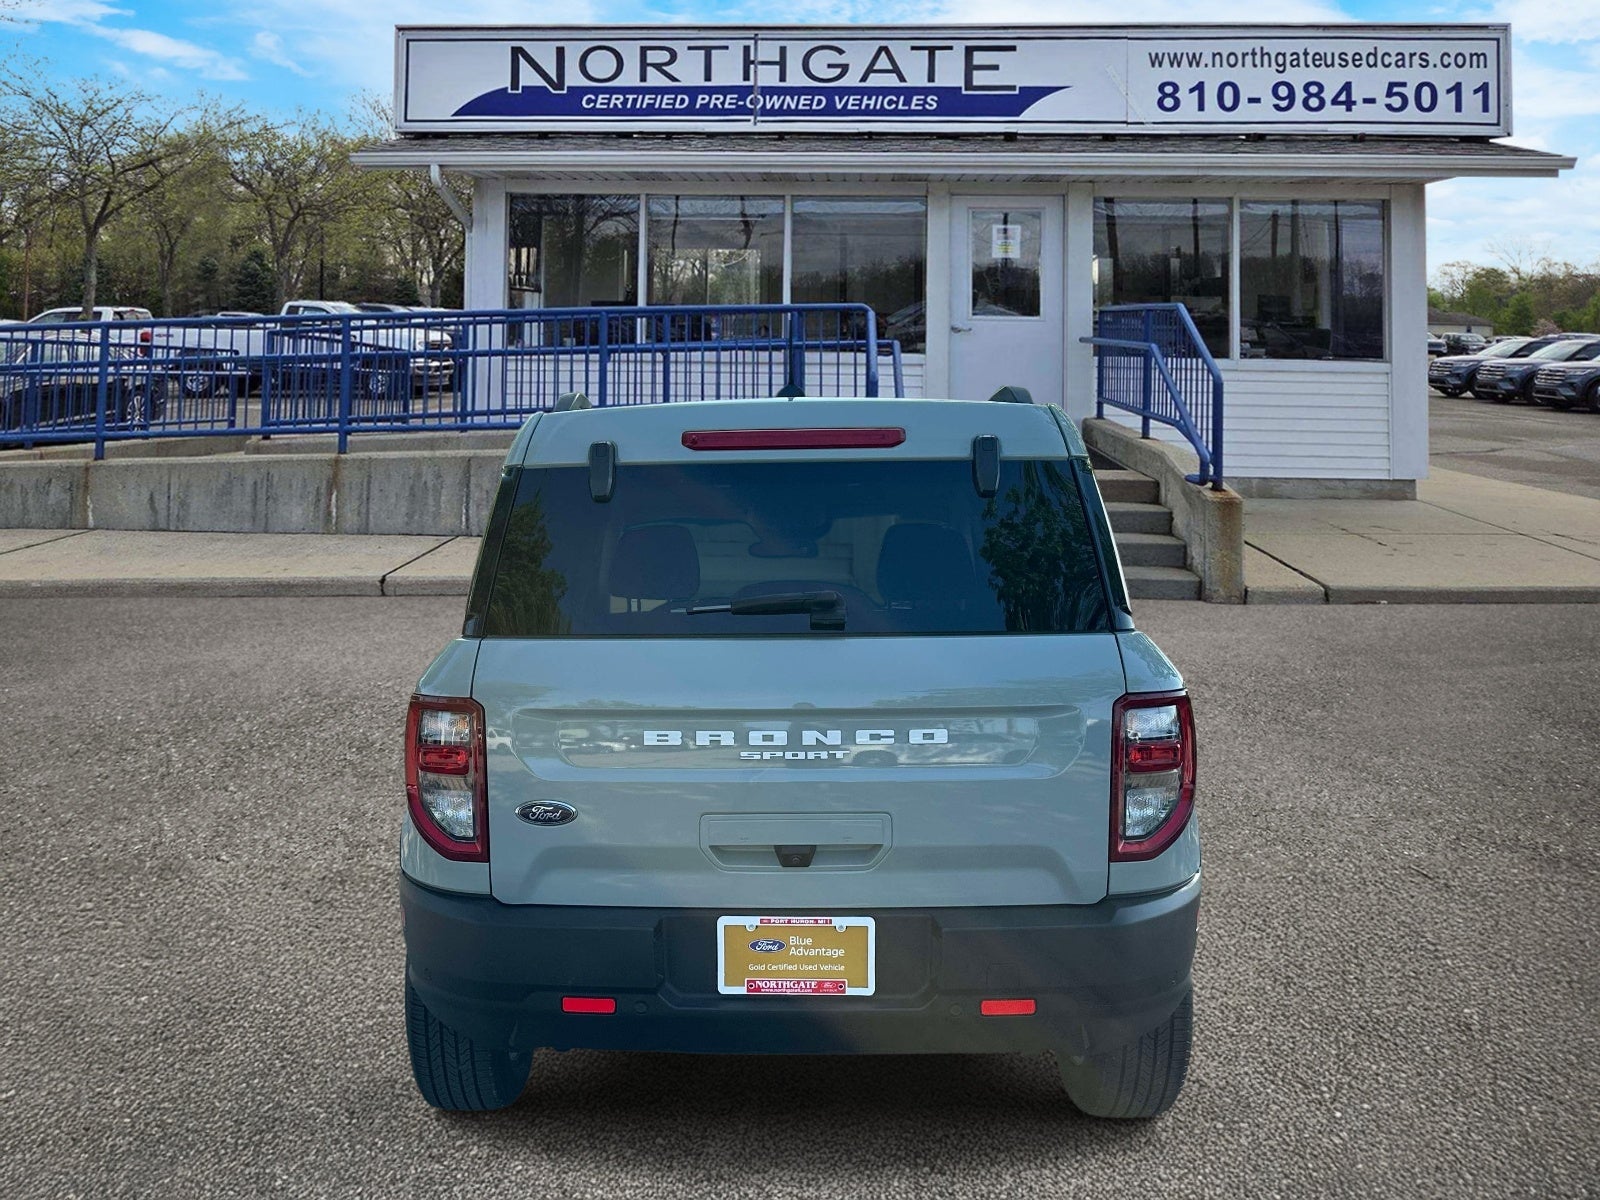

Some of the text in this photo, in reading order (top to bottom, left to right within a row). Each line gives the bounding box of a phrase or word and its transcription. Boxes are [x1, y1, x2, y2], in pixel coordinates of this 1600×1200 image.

[1148, 46, 1488, 73] www.northgateusedcars.com
[509, 45, 1017, 91] NORTHGATE
[581, 94, 938, 111] CERTIFIED PRE-OWNED VEHICLES
[1157, 81, 1491, 114] 810-984-5011
[643, 729, 949, 747] BRONCO
[740, 750, 850, 760] SPORT
[528, 805, 562, 821] Ford
[756, 940, 779, 951] Ford
[789, 936, 812, 946] Blue
[789, 947, 845, 958] Advantage
[749, 963, 845, 972] Gold Certified Used Vehicle
[755, 981, 818, 989] NORTHGATE
